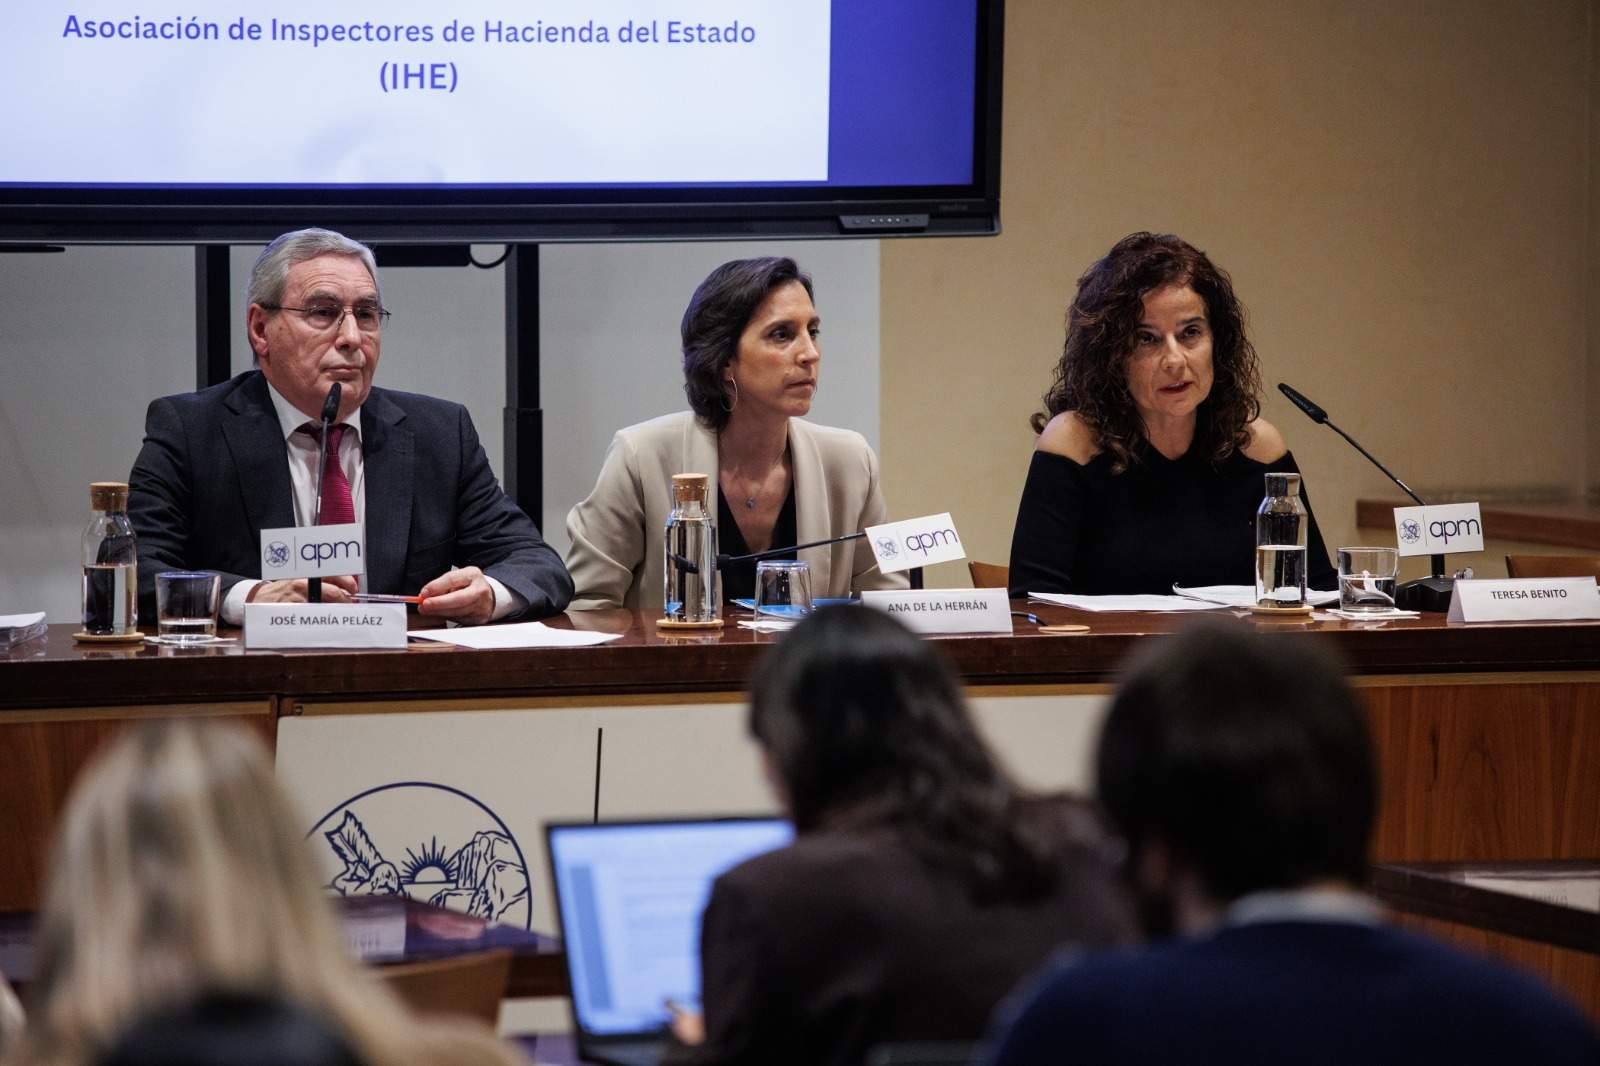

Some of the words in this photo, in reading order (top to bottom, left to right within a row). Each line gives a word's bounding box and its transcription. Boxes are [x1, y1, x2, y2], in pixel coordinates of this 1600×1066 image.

[62, 14, 219, 41] Asociación
[227, 16, 263, 41] de
[271, 17, 435, 48] Inspectores
[442, 18, 476, 43] de
[484, 19, 611, 44] Hacienda
[617, 19, 660, 44] del
[667, 19, 756, 44] Estado
[379, 61, 459, 94] (IHE)
[906, 528, 958, 557] apm
[1429, 518, 1480, 545] apm
[300, 540, 360, 568] apm
[888, 602, 911, 613] ANA
[913, 602, 927, 612] DE
[930, 602, 943, 612] LA
[945, 600, 988, 612] HERRÁN
[1491, 590, 1528, 600] TERESA
[1530, 588, 1567, 599] BENITO
[269, 613, 297, 626] JOSÉ
[299, 613, 339, 626] MARÍA
[342, 613, 383, 626] PELÁEZ
